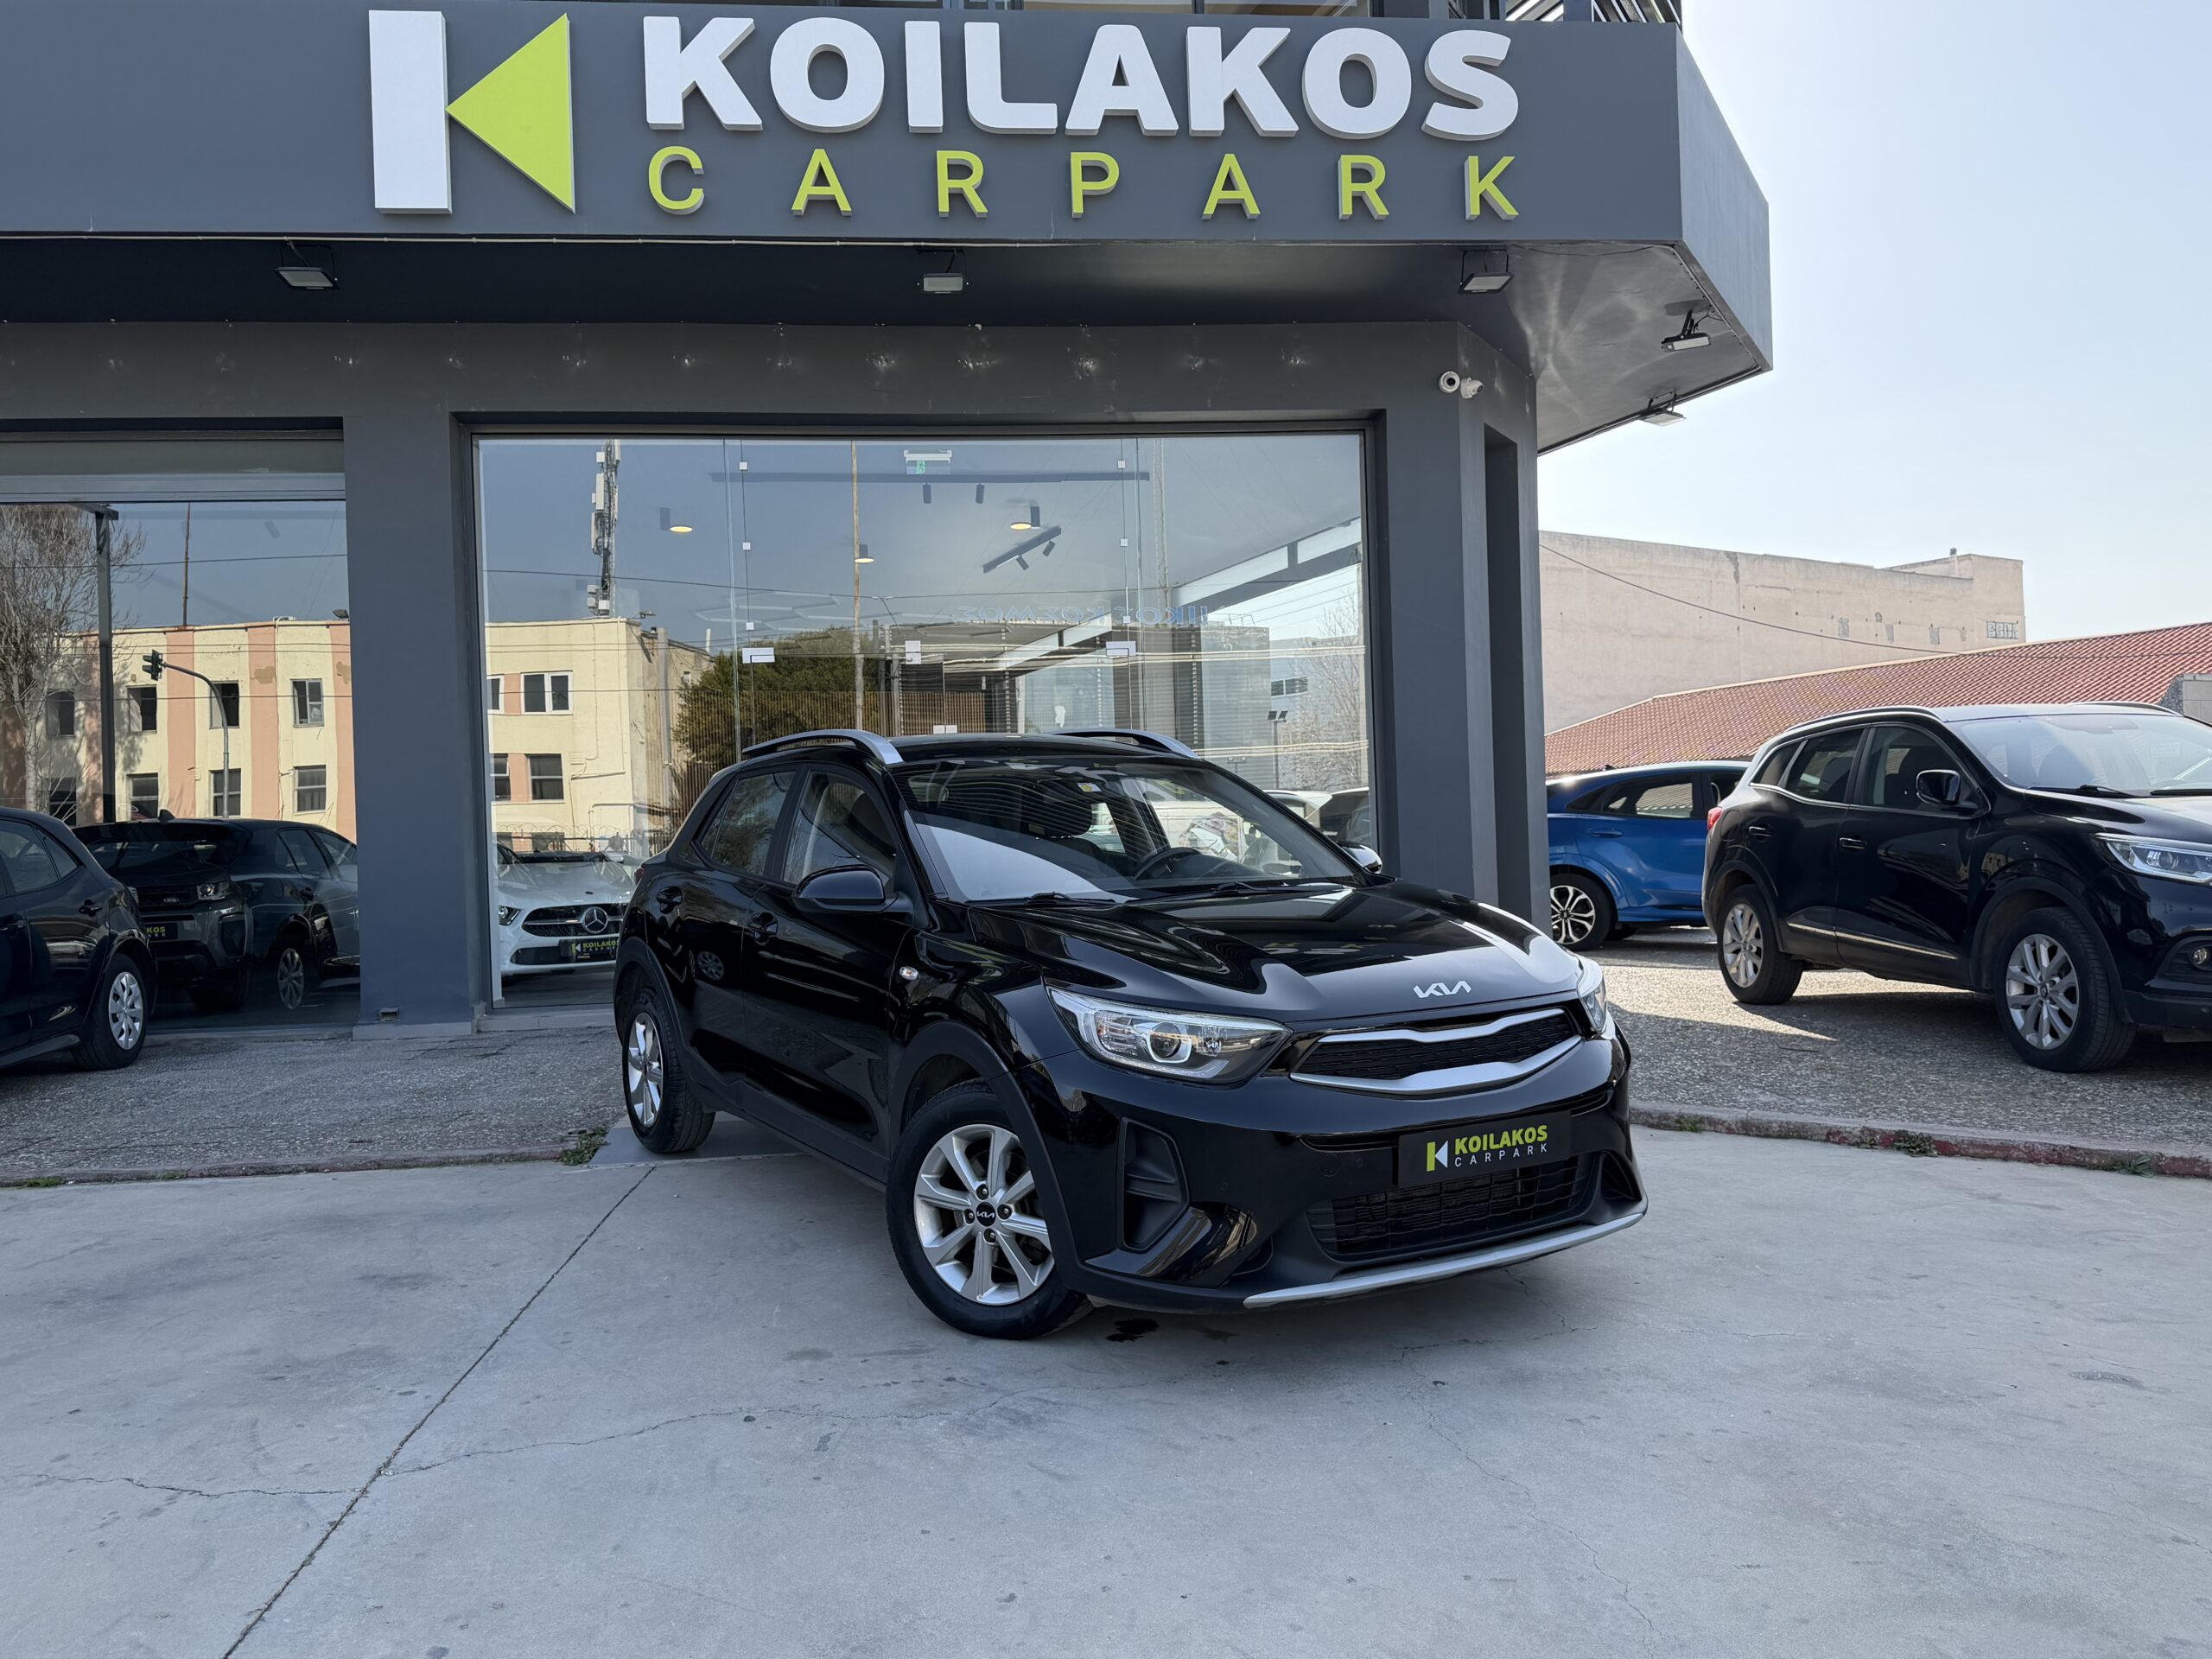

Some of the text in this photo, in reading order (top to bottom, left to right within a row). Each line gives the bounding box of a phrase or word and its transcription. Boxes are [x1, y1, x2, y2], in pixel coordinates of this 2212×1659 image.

[643, 16, 1519, 141] KOILAKOS
[648, 146, 1519, 220] CARPARK
[1413, 981, 1472, 999] KIA
[1454, 1125, 1548, 1154] KOILAKOS
[1454, 1142, 1548, 1166] CARPARK
